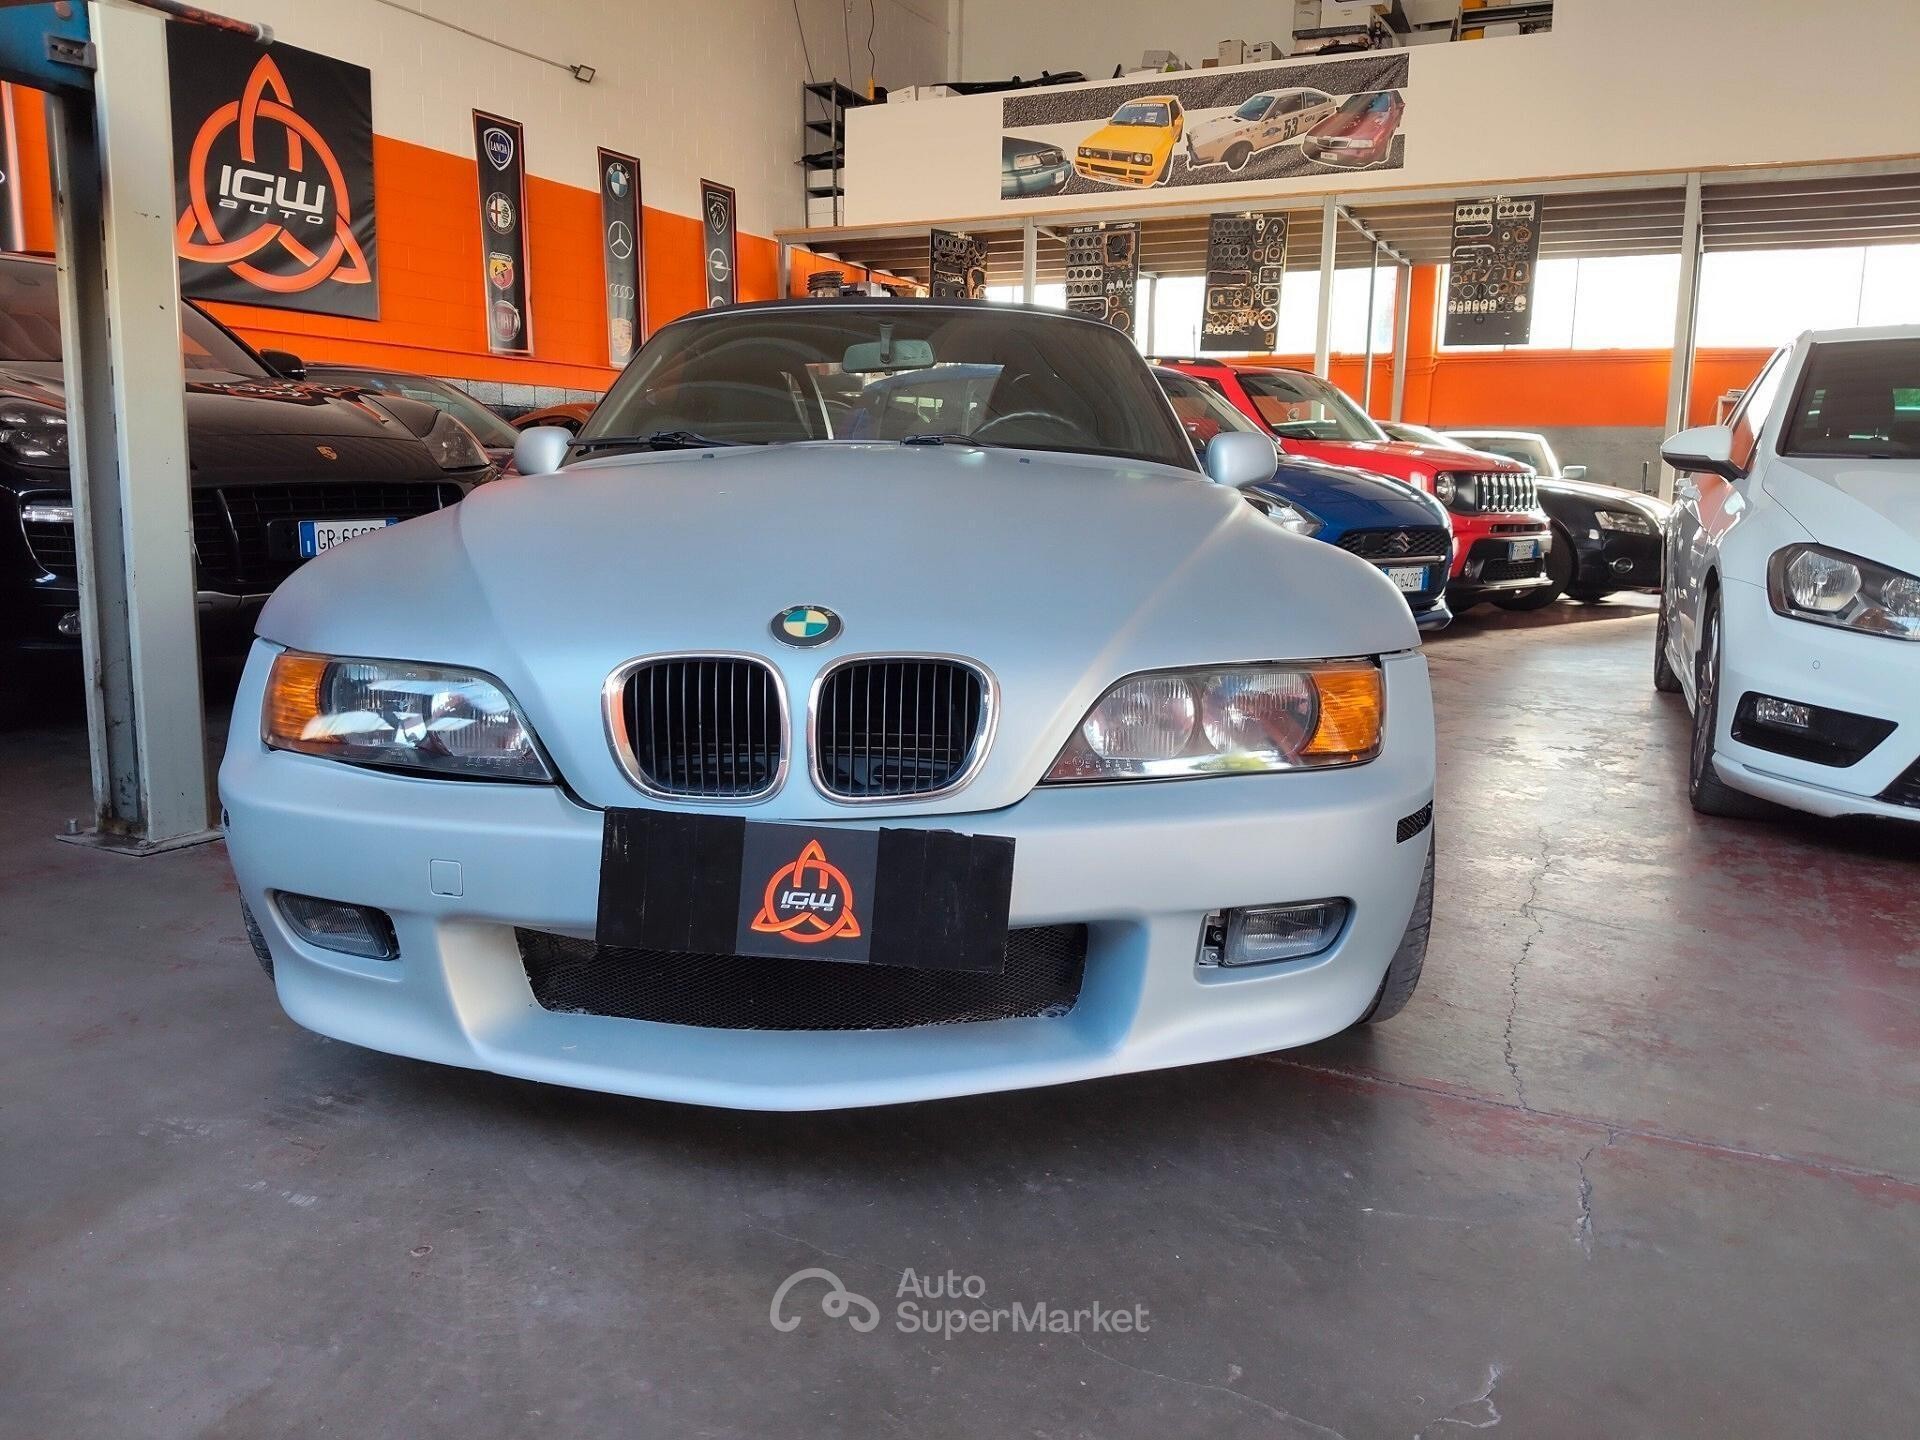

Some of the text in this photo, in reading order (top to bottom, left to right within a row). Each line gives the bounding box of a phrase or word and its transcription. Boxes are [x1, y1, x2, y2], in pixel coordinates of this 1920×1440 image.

[1283, 117, 1298, 141] 53
[490, 140, 508, 155] LANCIA
[609, 163, 630, 179] BMW
[219, 164, 326, 214] IGW
[317, 528, 336, 550] GR
[782, 605, 836, 617] BMW
[781, 890, 837, 907] IGW
